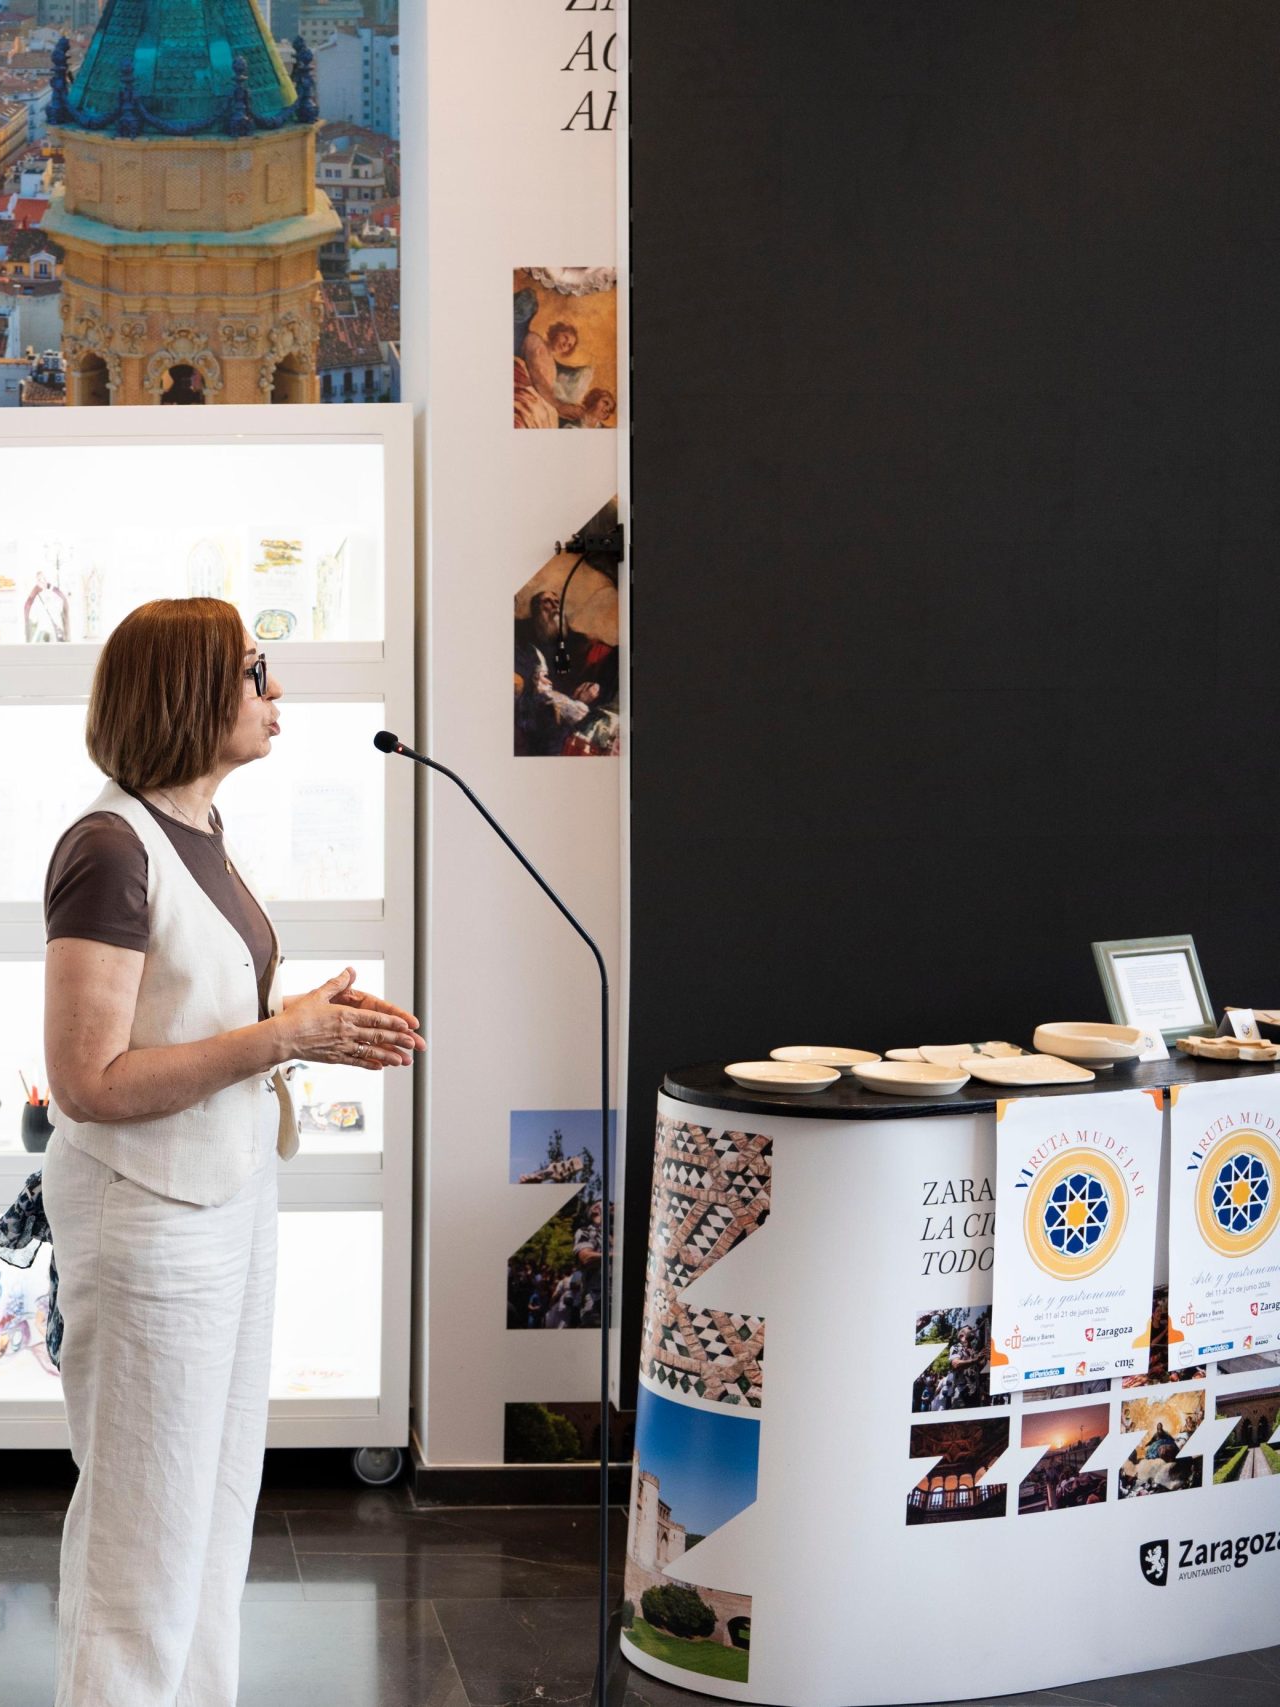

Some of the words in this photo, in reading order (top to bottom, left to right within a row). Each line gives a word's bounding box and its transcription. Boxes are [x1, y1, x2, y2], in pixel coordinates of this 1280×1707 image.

[1187, 1151, 1203, 1170] VI
[1198, 1114, 1234, 1152] RUTA
[1015, 1169, 1034, 1188] VI
[1028, 1133, 1069, 1169] RUTA
[920, 1215, 955, 1241] LA
[921, 1246, 995, 1276] TODO
[1057, 1285, 1126, 1310] gastronomía
[1205, 1290, 1214, 1298] del
[1236, 1285, 1244, 1293] de
[1034, 1313, 1044, 1321] del
[1046, 1312, 1052, 1320] 11
[1061, 1310, 1068, 1318] 21
[1070, 1309, 1077, 1317] de
[1077, 1308, 1094, 1318] junio
[1096, 1325, 1133, 1338] Zaragoza
[1114, 1359, 1135, 1369] cmg
[1178, 1564, 1232, 1581] AYUNTAMIENTO
